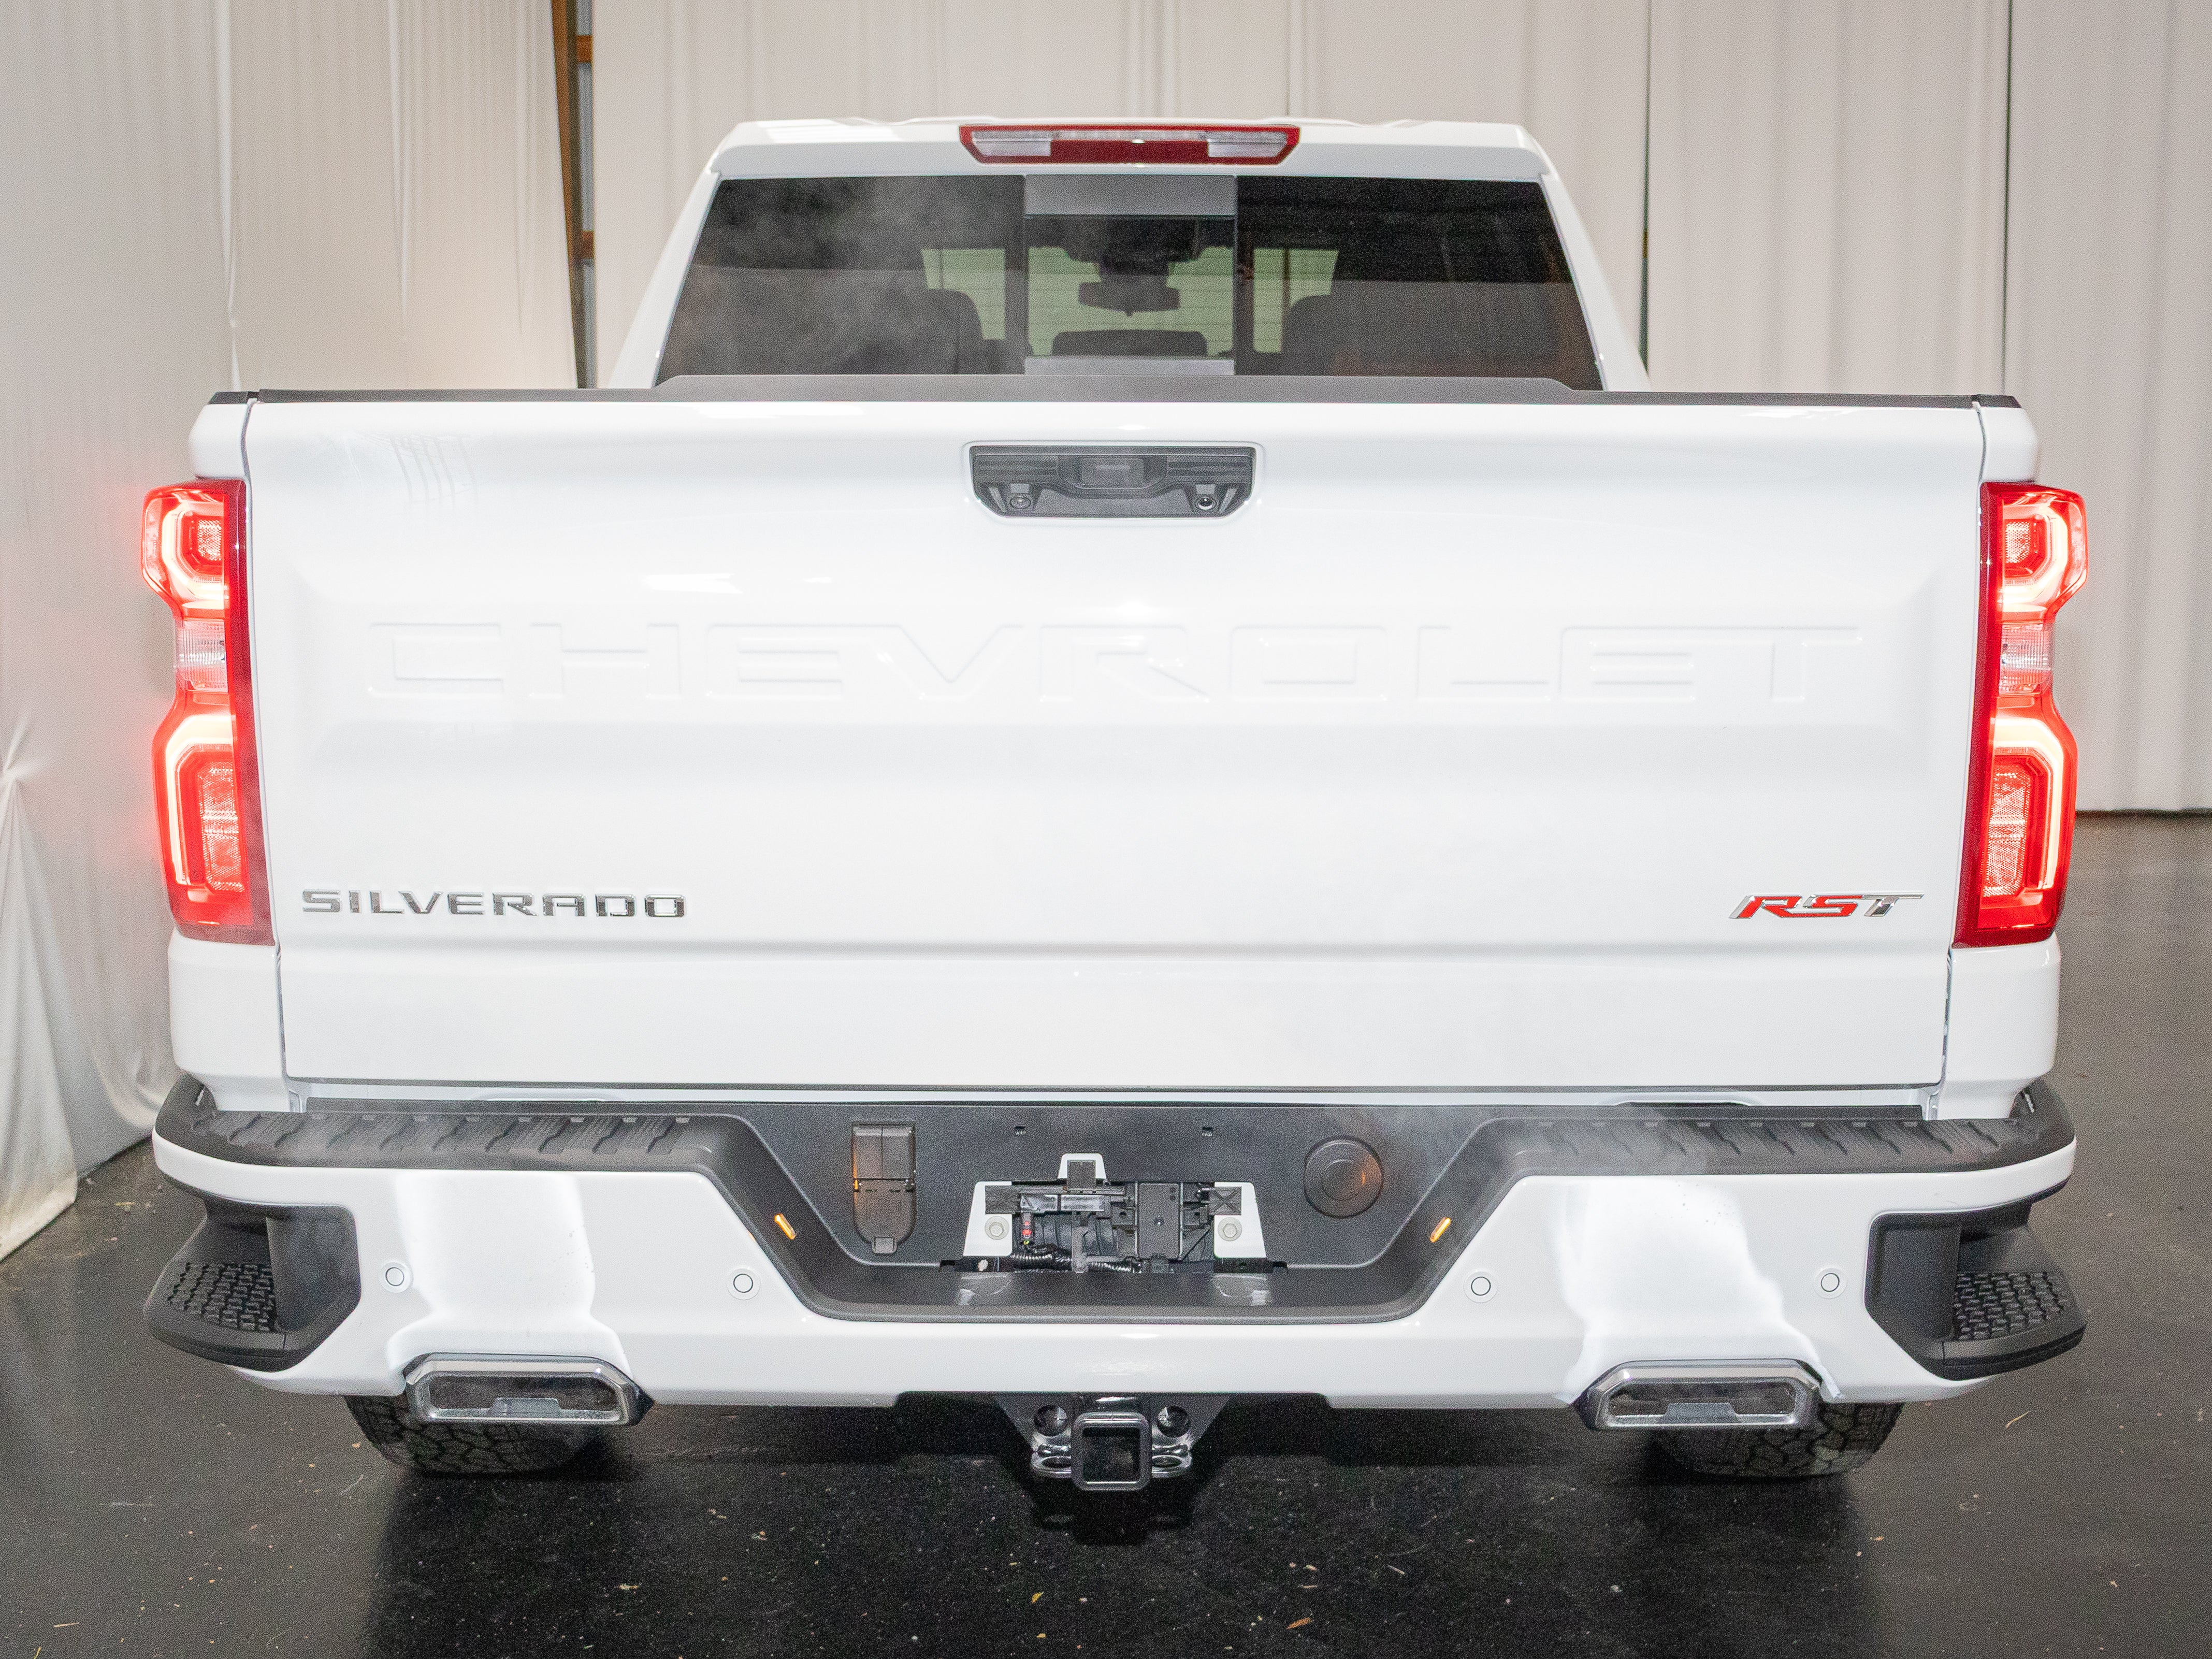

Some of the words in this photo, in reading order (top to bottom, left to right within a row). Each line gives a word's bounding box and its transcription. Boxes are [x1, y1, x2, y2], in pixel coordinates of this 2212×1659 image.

[367, 623, 1862, 703] CHEVROLET
[302, 889, 686, 917] SILVERADO
[1729, 893, 1925, 919] RST
